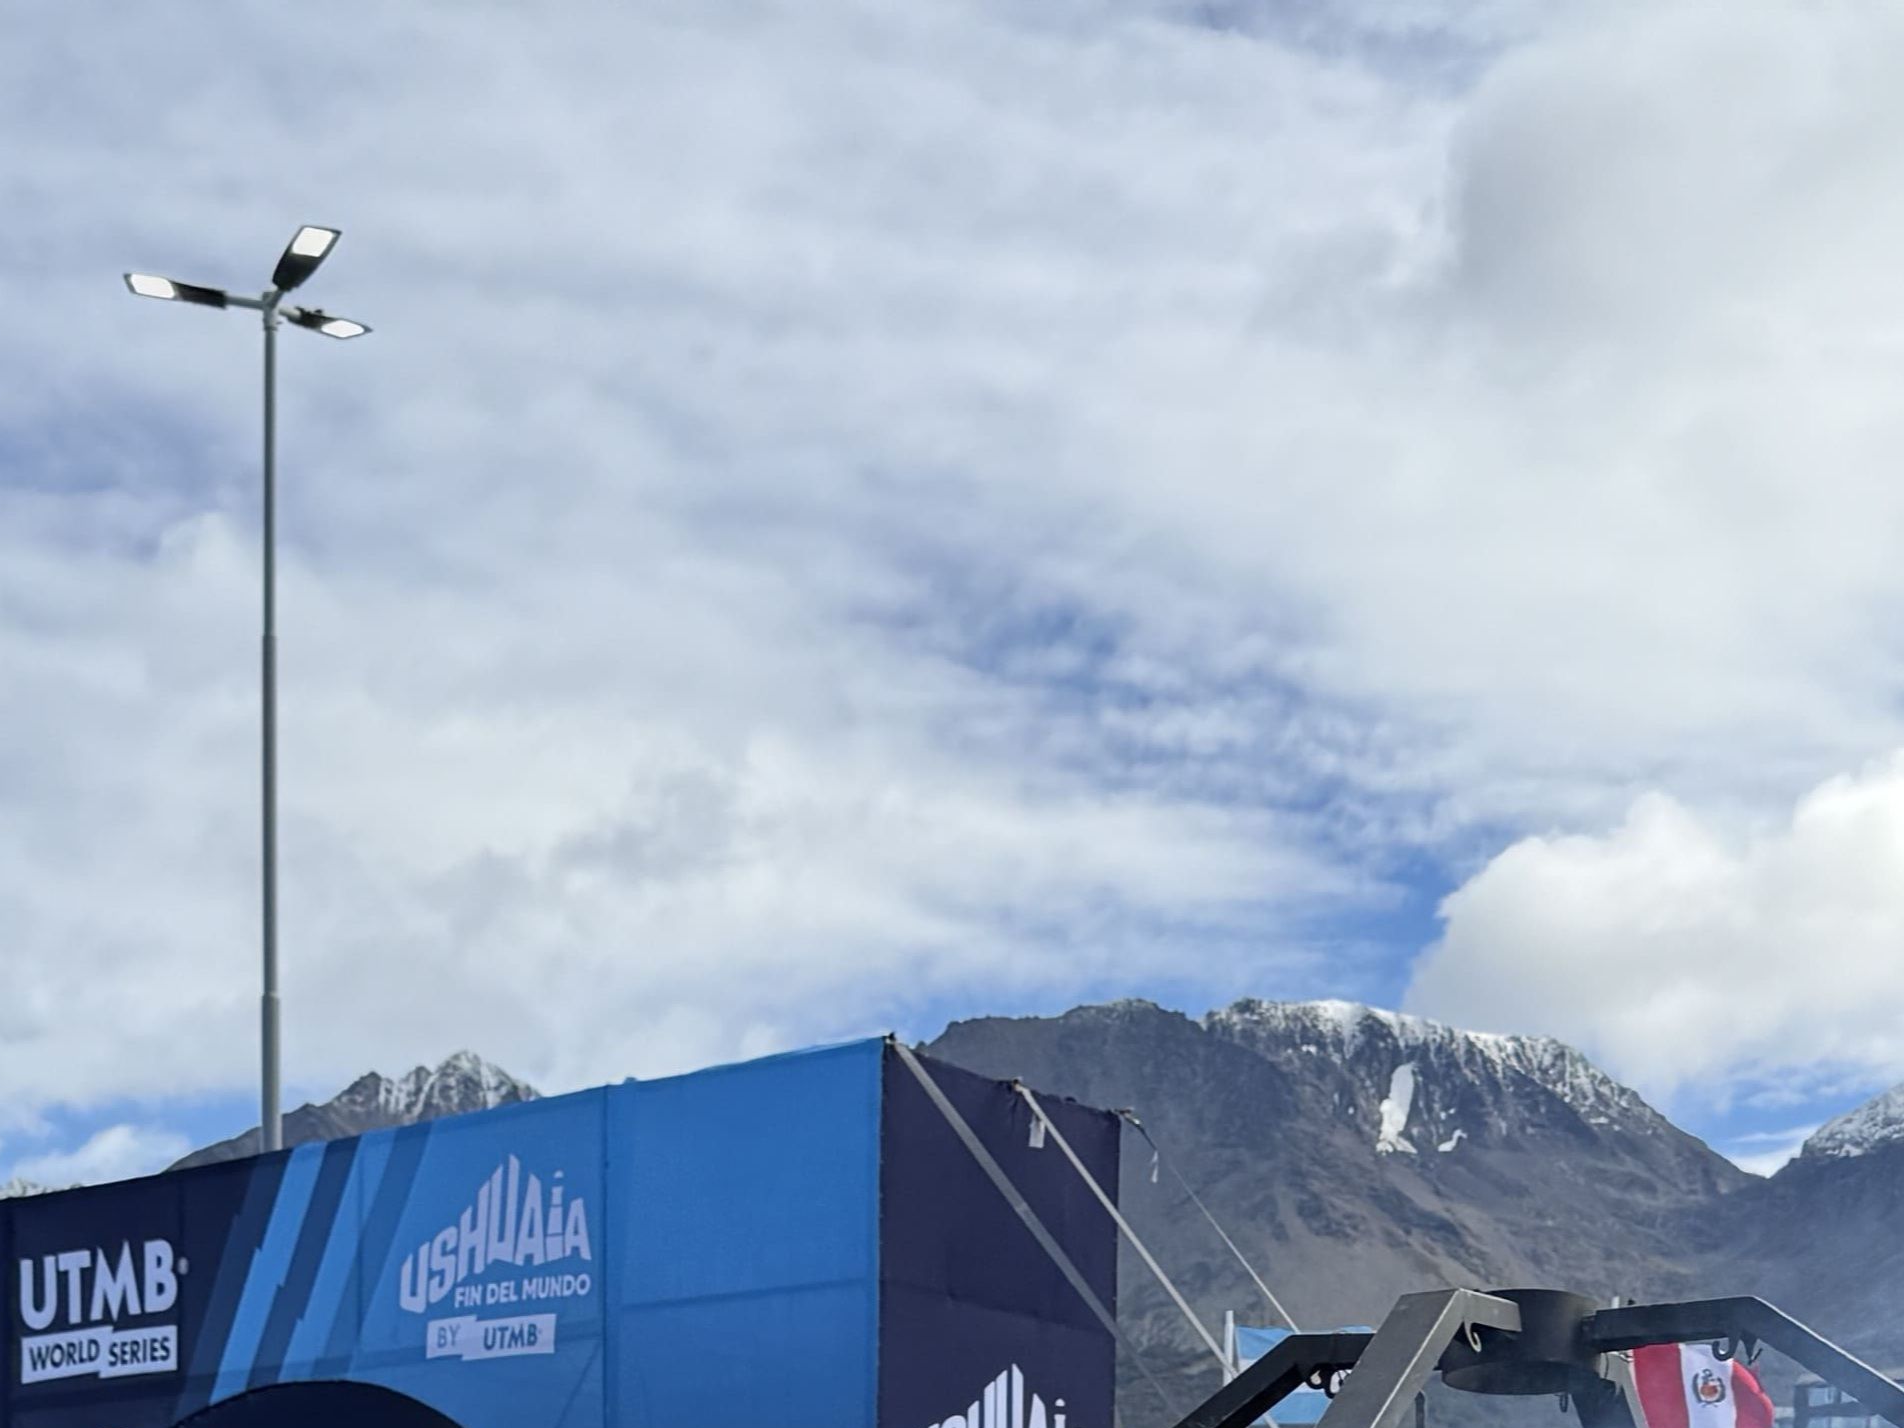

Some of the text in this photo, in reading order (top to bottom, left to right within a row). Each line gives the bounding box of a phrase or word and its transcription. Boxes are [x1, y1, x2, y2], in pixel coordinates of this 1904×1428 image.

[20, 1238, 178, 1330] UTMB
[454, 1273, 591, 1308] FIN DEL MUNDO
[30, 1336, 171, 1371] WORLD SERIES
[437, 1323, 538, 1350] BY UTMB
